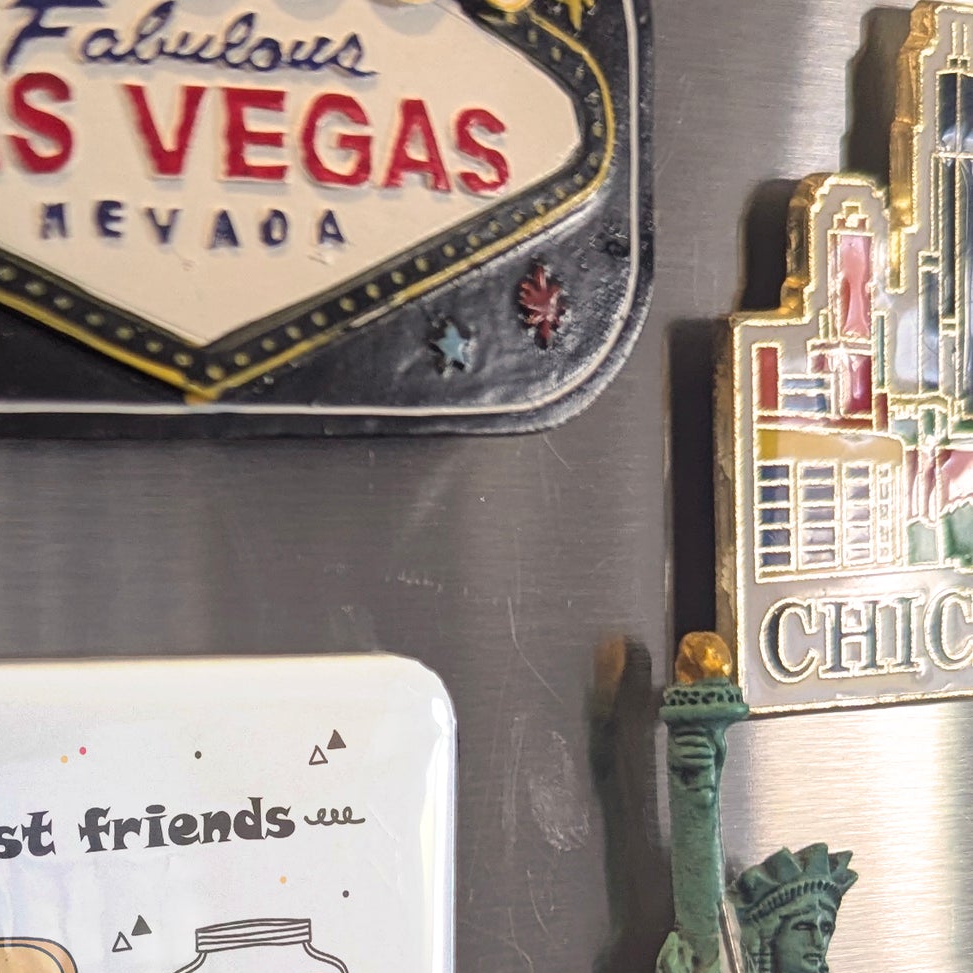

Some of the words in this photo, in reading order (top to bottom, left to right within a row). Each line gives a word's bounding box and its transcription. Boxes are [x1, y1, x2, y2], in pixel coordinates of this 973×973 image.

[3, 0, 378, 78] Fabulous
[124, 84, 510, 195] VEGAS
[39, 199, 346, 249] NEVADA
[78, 797, 296, 854] friends
